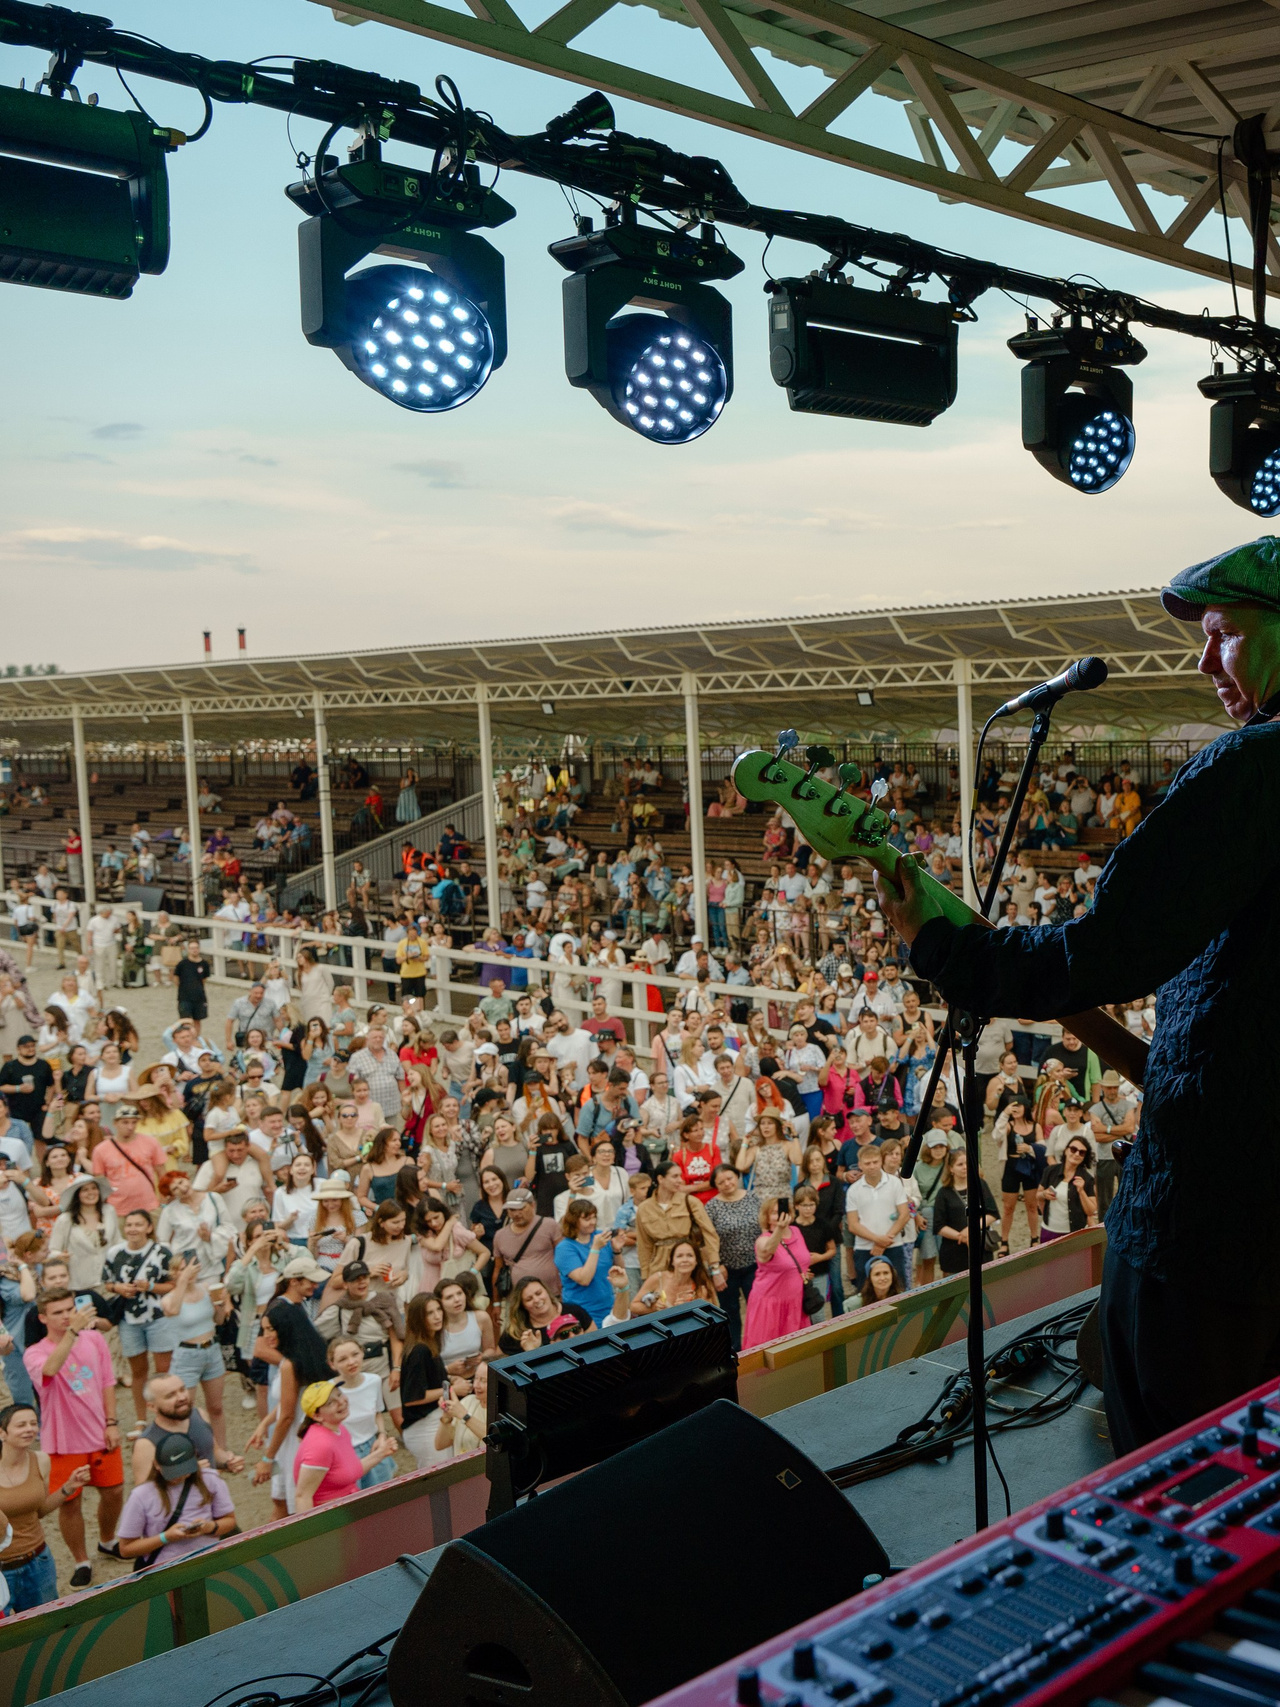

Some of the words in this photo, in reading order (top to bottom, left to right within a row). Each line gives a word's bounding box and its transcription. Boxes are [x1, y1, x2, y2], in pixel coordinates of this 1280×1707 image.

[413, 227, 441, 239] LIGHT
[643, 276, 659, 286] SKY
[660, 280, 682, 291] LIGHT
